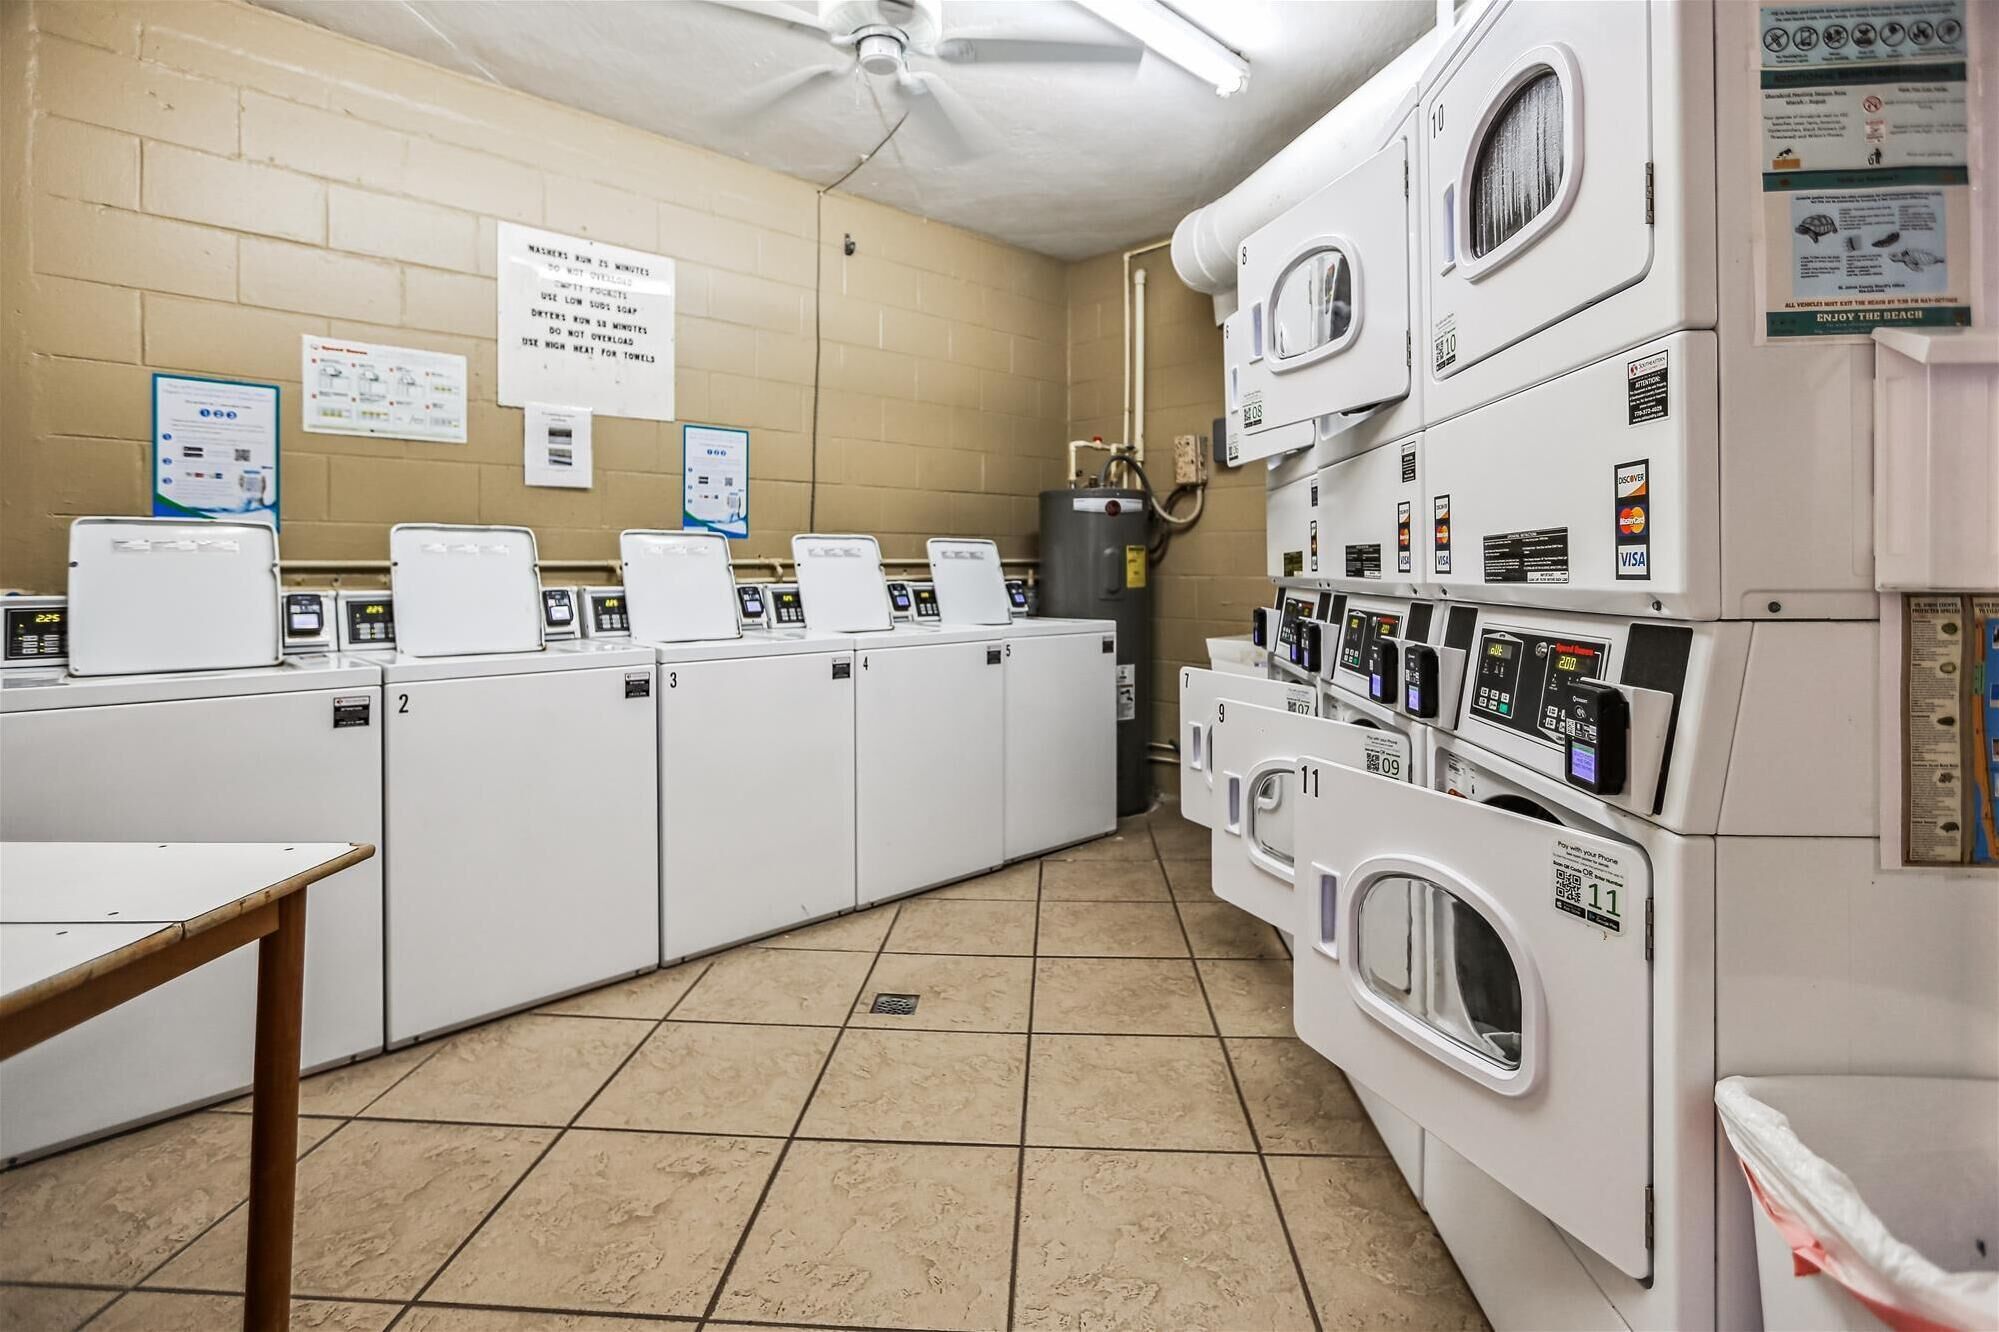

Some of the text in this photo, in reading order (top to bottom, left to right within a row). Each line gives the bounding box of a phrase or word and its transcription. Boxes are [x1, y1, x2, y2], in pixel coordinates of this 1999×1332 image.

[1432, 104, 1444, 139] 10
[528, 244, 568, 260] WASHERS
[575, 254, 592, 264] RUN
[615, 263, 650, 276] MINUTES
[1242, 246, 1247, 265] 8
[541, 292, 637, 315] USE LOW SUDS SOAP
[531, 308, 566, 322] DRYERS
[574, 316, 590, 325] RUN
[613, 322, 648, 335] MINUTES
[1817, 310, 1922, 322] ENJOY THE BEACH
[549, 326, 634, 346] DO NOT OVERLOAD
[1446, 334, 1456, 356] 10
[522, 337, 655, 363] USE HIGH HEAT FOR TOWELS
[1252, 404, 1262, 419] 08
[1618, 473, 1644, 484] DISCOVER
[1438, 556, 1449, 565] VISA
[1620, 552, 1645, 566] VISA
[1006, 644, 1011, 657] 5
[863, 656, 868, 671] 4
[670, 672, 677, 688] 3
[1184, 673, 1190, 688] 7
[399, 694, 409, 714] 2
[1218, 703, 1225, 722] 9
[1298, 703, 1309, 715] 07
[1382, 758, 1399, 775] 09
[1301, 765, 1319, 798] 11
[1558, 840, 1569, 850] Pay
[1584, 849, 1597, 858] your
[1598, 853, 1618, 864] Phone
[1583, 868, 1594, 877] OR
[1589, 883, 1620, 917] 11
